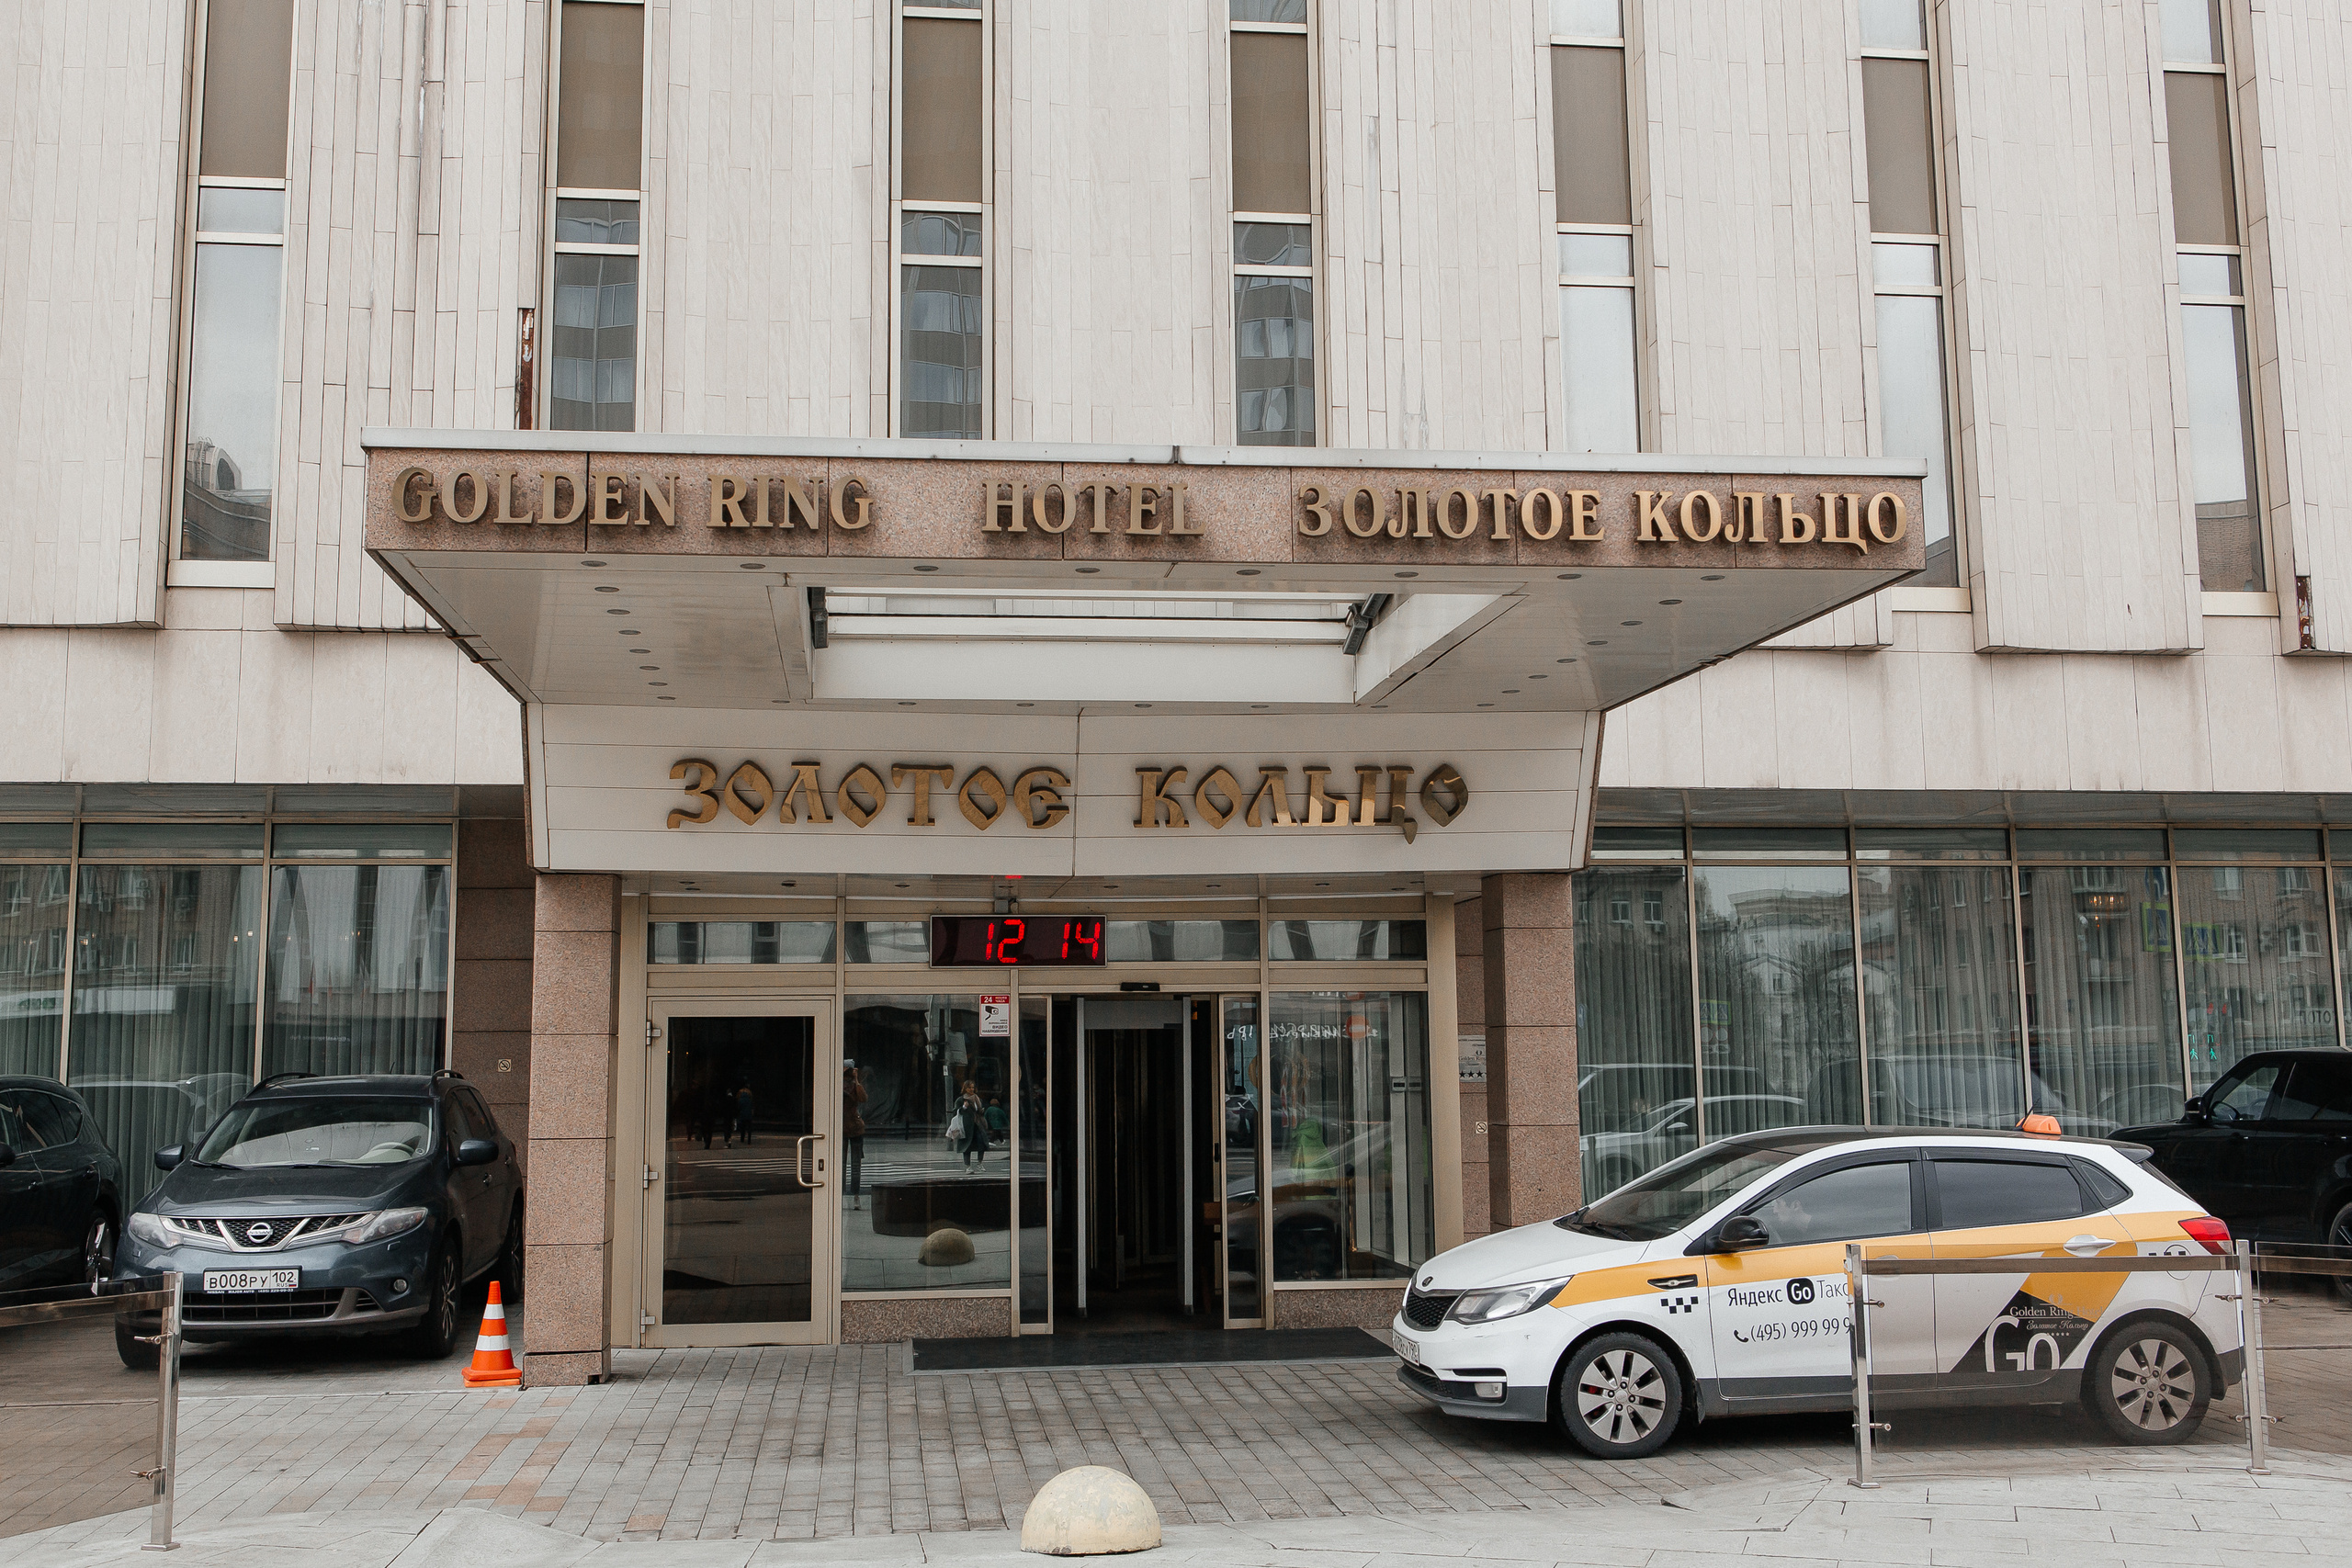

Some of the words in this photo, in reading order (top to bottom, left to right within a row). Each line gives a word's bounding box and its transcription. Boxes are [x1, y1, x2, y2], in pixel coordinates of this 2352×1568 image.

[391, 467, 680, 527] GOLDEN
[707, 472, 876, 531] RING
[981, 479, 1205, 536] HOTEL
[1297, 483, 1606, 541] ЗОЛОТОЕ
[1632, 490, 1908, 557] КОЛЬЦО
[1132, 762, 1470, 845] КОЛЬЦО
[985, 919, 1025, 963] 12
[1061, 921, 1102, 960] 14
[272, 1271, 294, 1283] 102
[1727, 1288, 1783, 1307] Яндекс
[1791, 1282, 1812, 1302] Go
[2009, 1305, 2046, 1317] Golden
[2050, 1306, 2074, 1319] Ring
[1750, 1322, 1787, 1343] (495)
[1792, 1320, 1818, 1338] 999
[1822, 1317, 1840, 1336] 99
